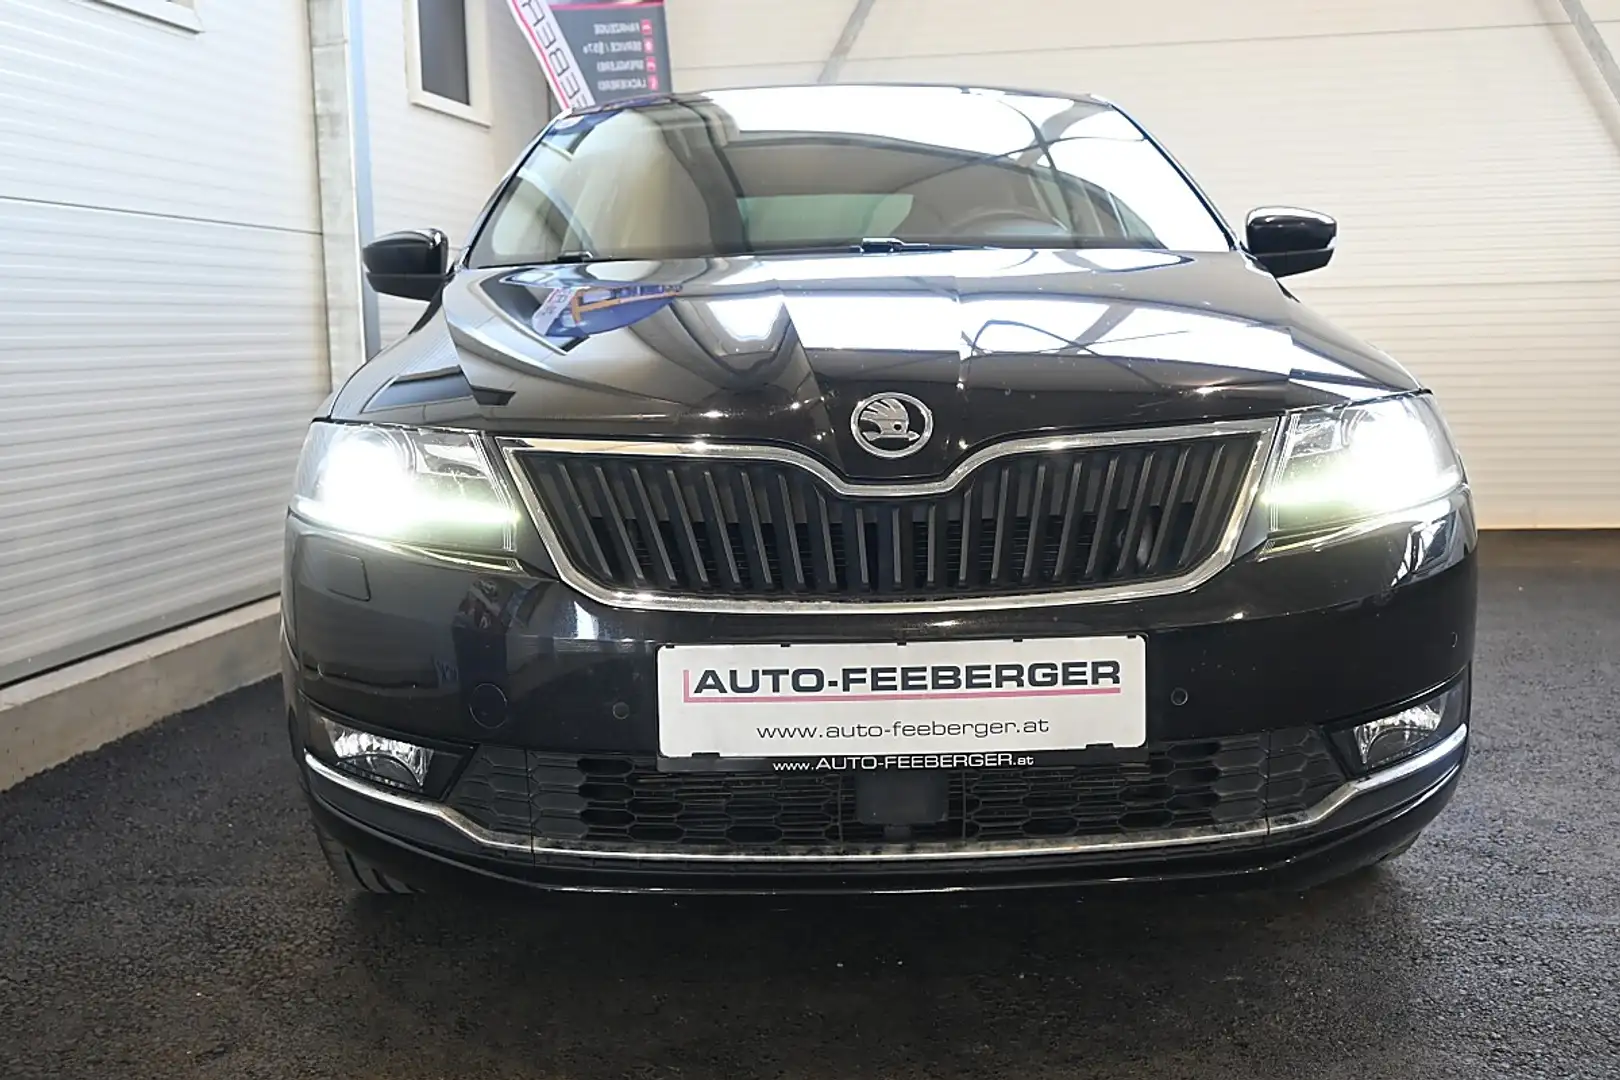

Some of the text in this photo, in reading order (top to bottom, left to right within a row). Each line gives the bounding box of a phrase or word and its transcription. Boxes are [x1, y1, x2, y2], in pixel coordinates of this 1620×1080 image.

[693, 660, 1121, 695] AUTO-FEEBERGER
[757, 719, 1049, 739] www.auto-feeberger.at
[773, 754, 1034, 771] www.AUTO-FEEBERGER.at
